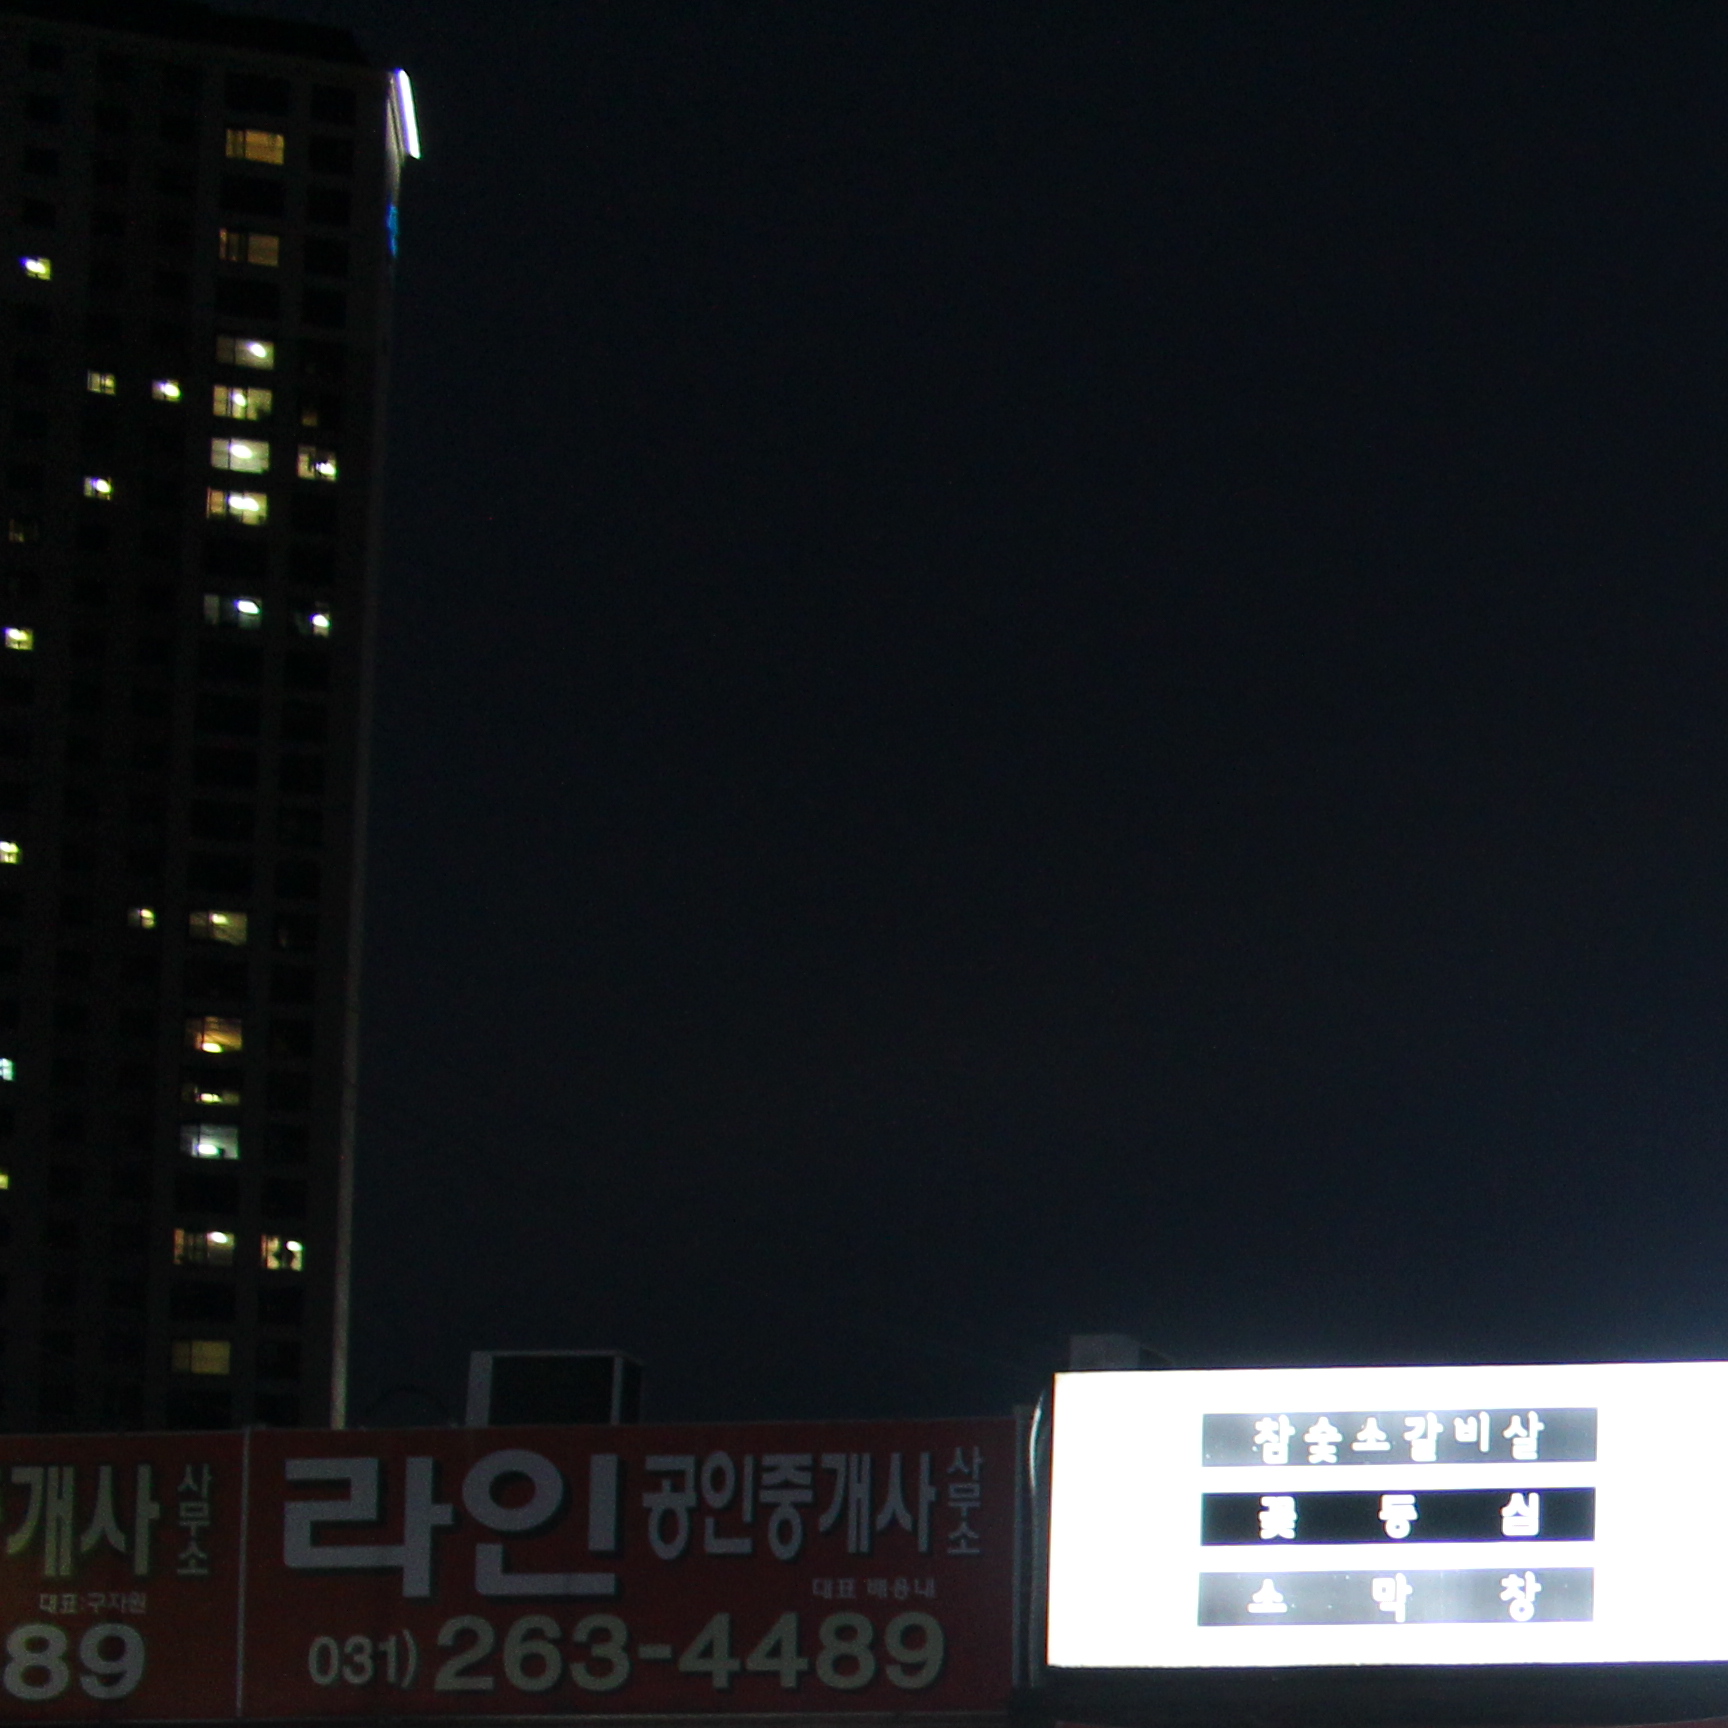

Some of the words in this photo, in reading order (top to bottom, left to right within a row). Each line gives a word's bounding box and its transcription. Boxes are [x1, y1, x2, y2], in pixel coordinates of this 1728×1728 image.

[177, 1463, 212, 1577] 사무소
[284, 1448, 618, 1598] 라인
[642, 1450, 938, 1562] 공인중개사
[946, 1446, 984, 1555] 사무소
[308, 1630, 420, 1689] 031)
[434, 1611, 946, 1693] 263-4489
